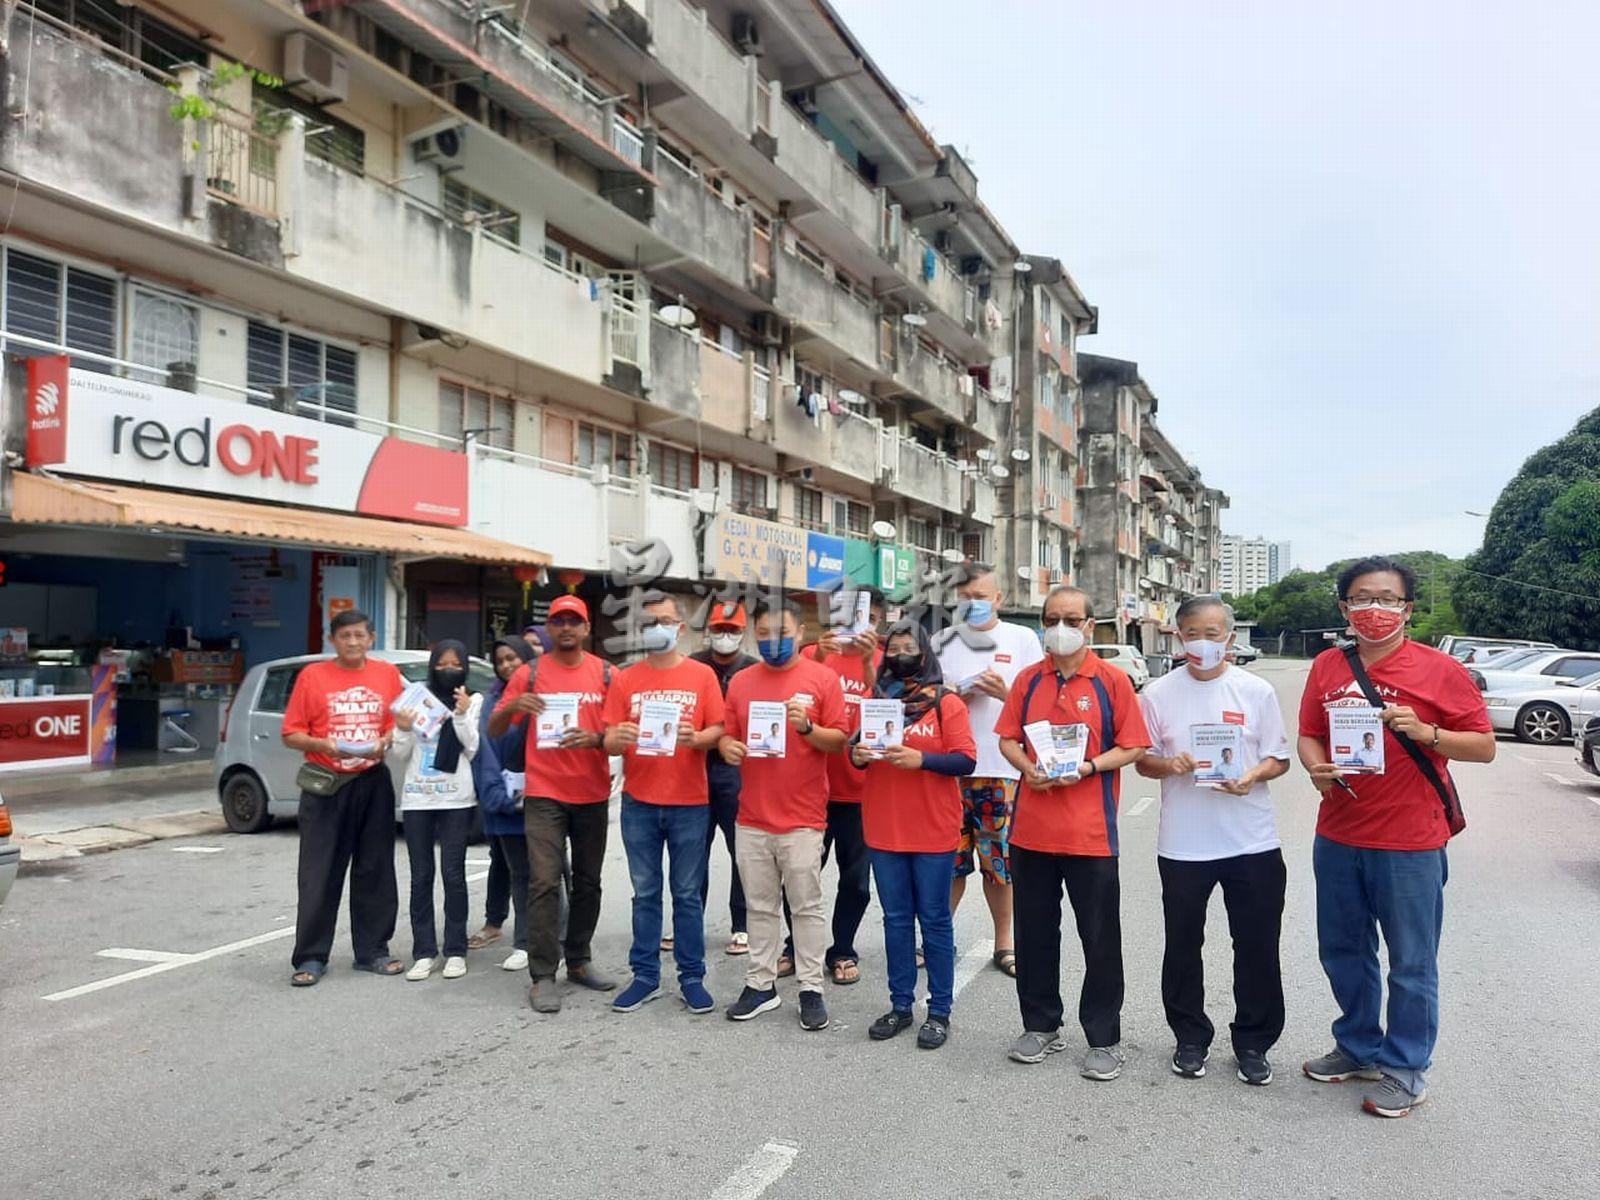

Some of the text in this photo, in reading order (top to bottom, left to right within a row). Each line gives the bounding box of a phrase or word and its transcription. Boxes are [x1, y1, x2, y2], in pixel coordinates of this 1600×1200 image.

[31, 417, 61, 431] hotlink
[724, 518, 802, 549] KEDAI MOTOSIKAL
[767, 545, 802, 566] MOTOR
